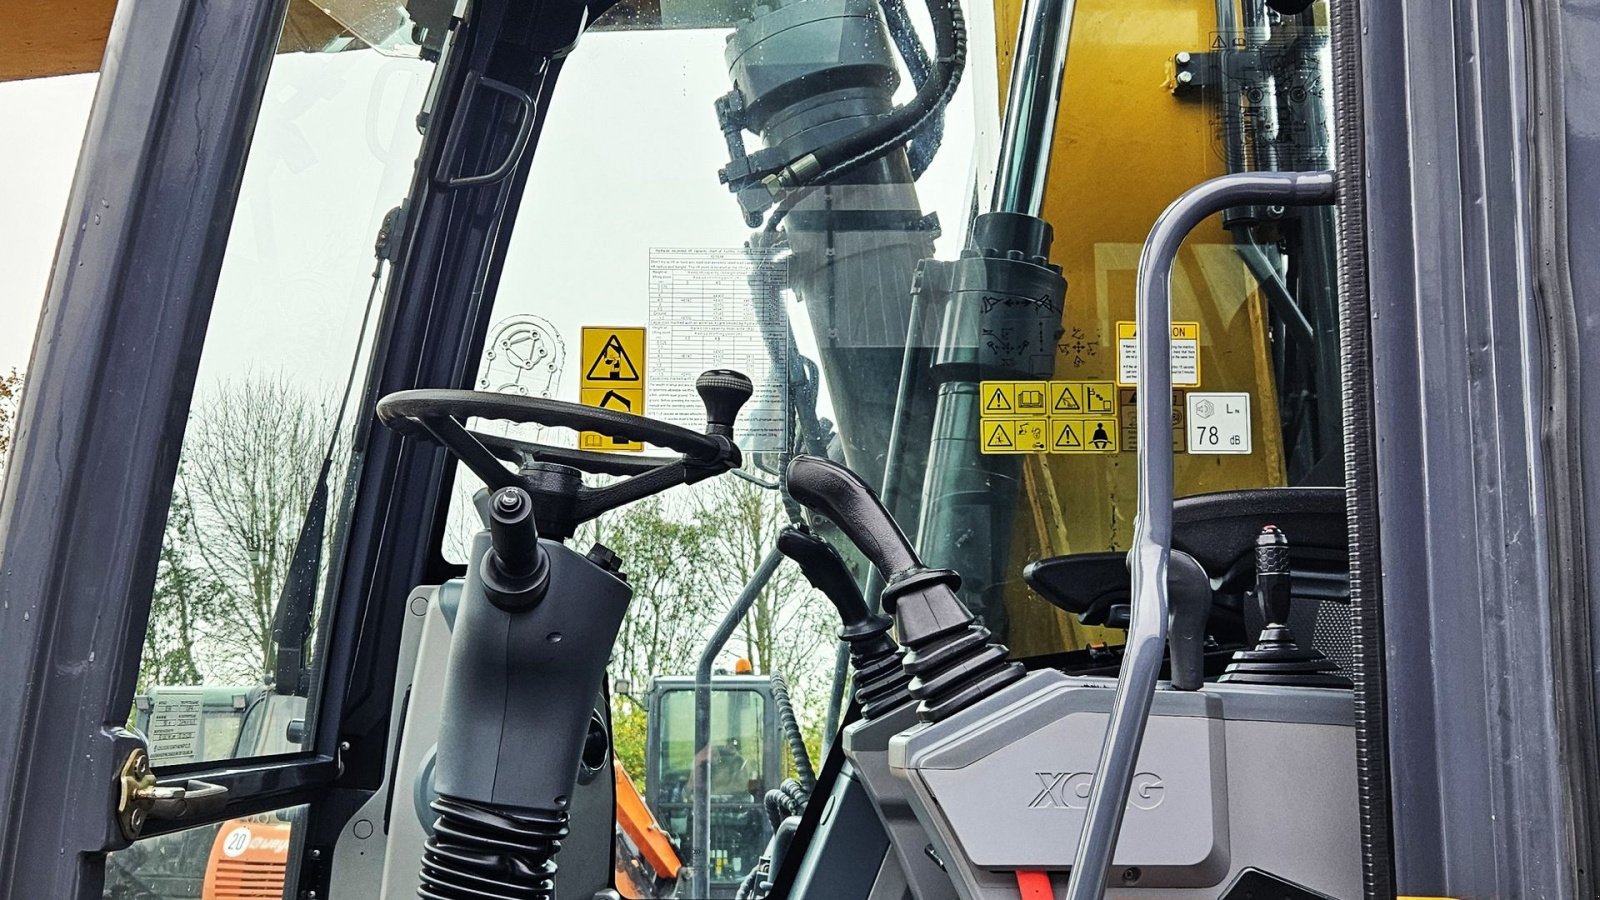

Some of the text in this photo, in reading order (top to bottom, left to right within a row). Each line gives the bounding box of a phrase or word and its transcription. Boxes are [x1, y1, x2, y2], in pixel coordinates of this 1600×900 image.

[1196, 426, 1219, 446] 78
[1230, 435, 1241, 446] dB
[1028, 771, 1166, 810] XCG
[227, 832, 247, 851] 20
